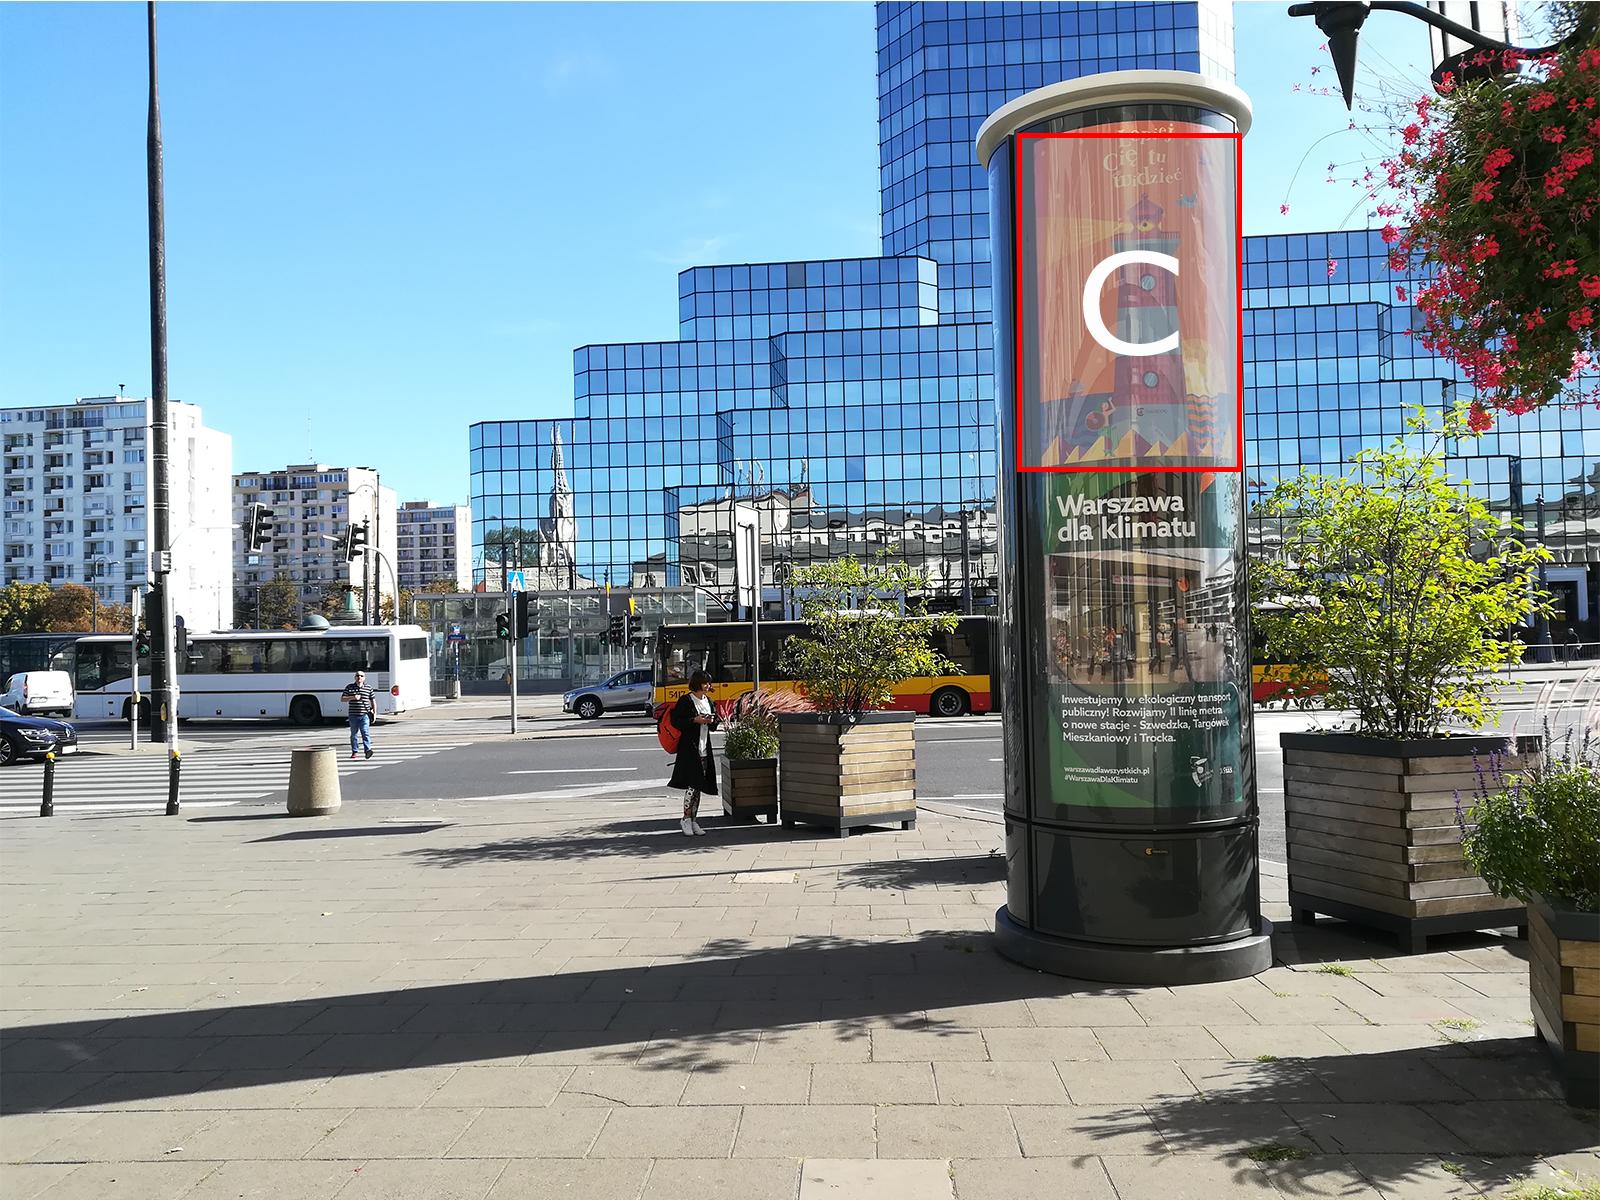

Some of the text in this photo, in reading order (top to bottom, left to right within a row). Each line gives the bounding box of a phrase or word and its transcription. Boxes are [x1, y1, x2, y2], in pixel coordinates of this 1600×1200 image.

[1148, 149, 1167, 165] tu
[1056, 493, 1184, 517] Warszawa
[1057, 515, 1196, 542] dla klimatu
[1062, 694, 1123, 706] Inwestujemy
[1138, 694, 1196, 706] ekologiczny
[1197, 693, 1231, 703] transport
[1062, 707, 1110, 719] publiczny!
[1112, 707, 1167, 719] Rozwijamy
[1178, 706, 1197, 718] linię
[1199, 707, 1223, 715] metra
[1100, 721, 1130, 732] stacje
[1140, 719, 1191, 730] Szwedzka,
[1063, 732, 1177, 744] Mieszkaniowy i Trocka.
[1064, 766, 1150, 775] warszawadlawszystkich.pl
[1064, 774, 1138, 783] #WarszawaDlaKlimatu
